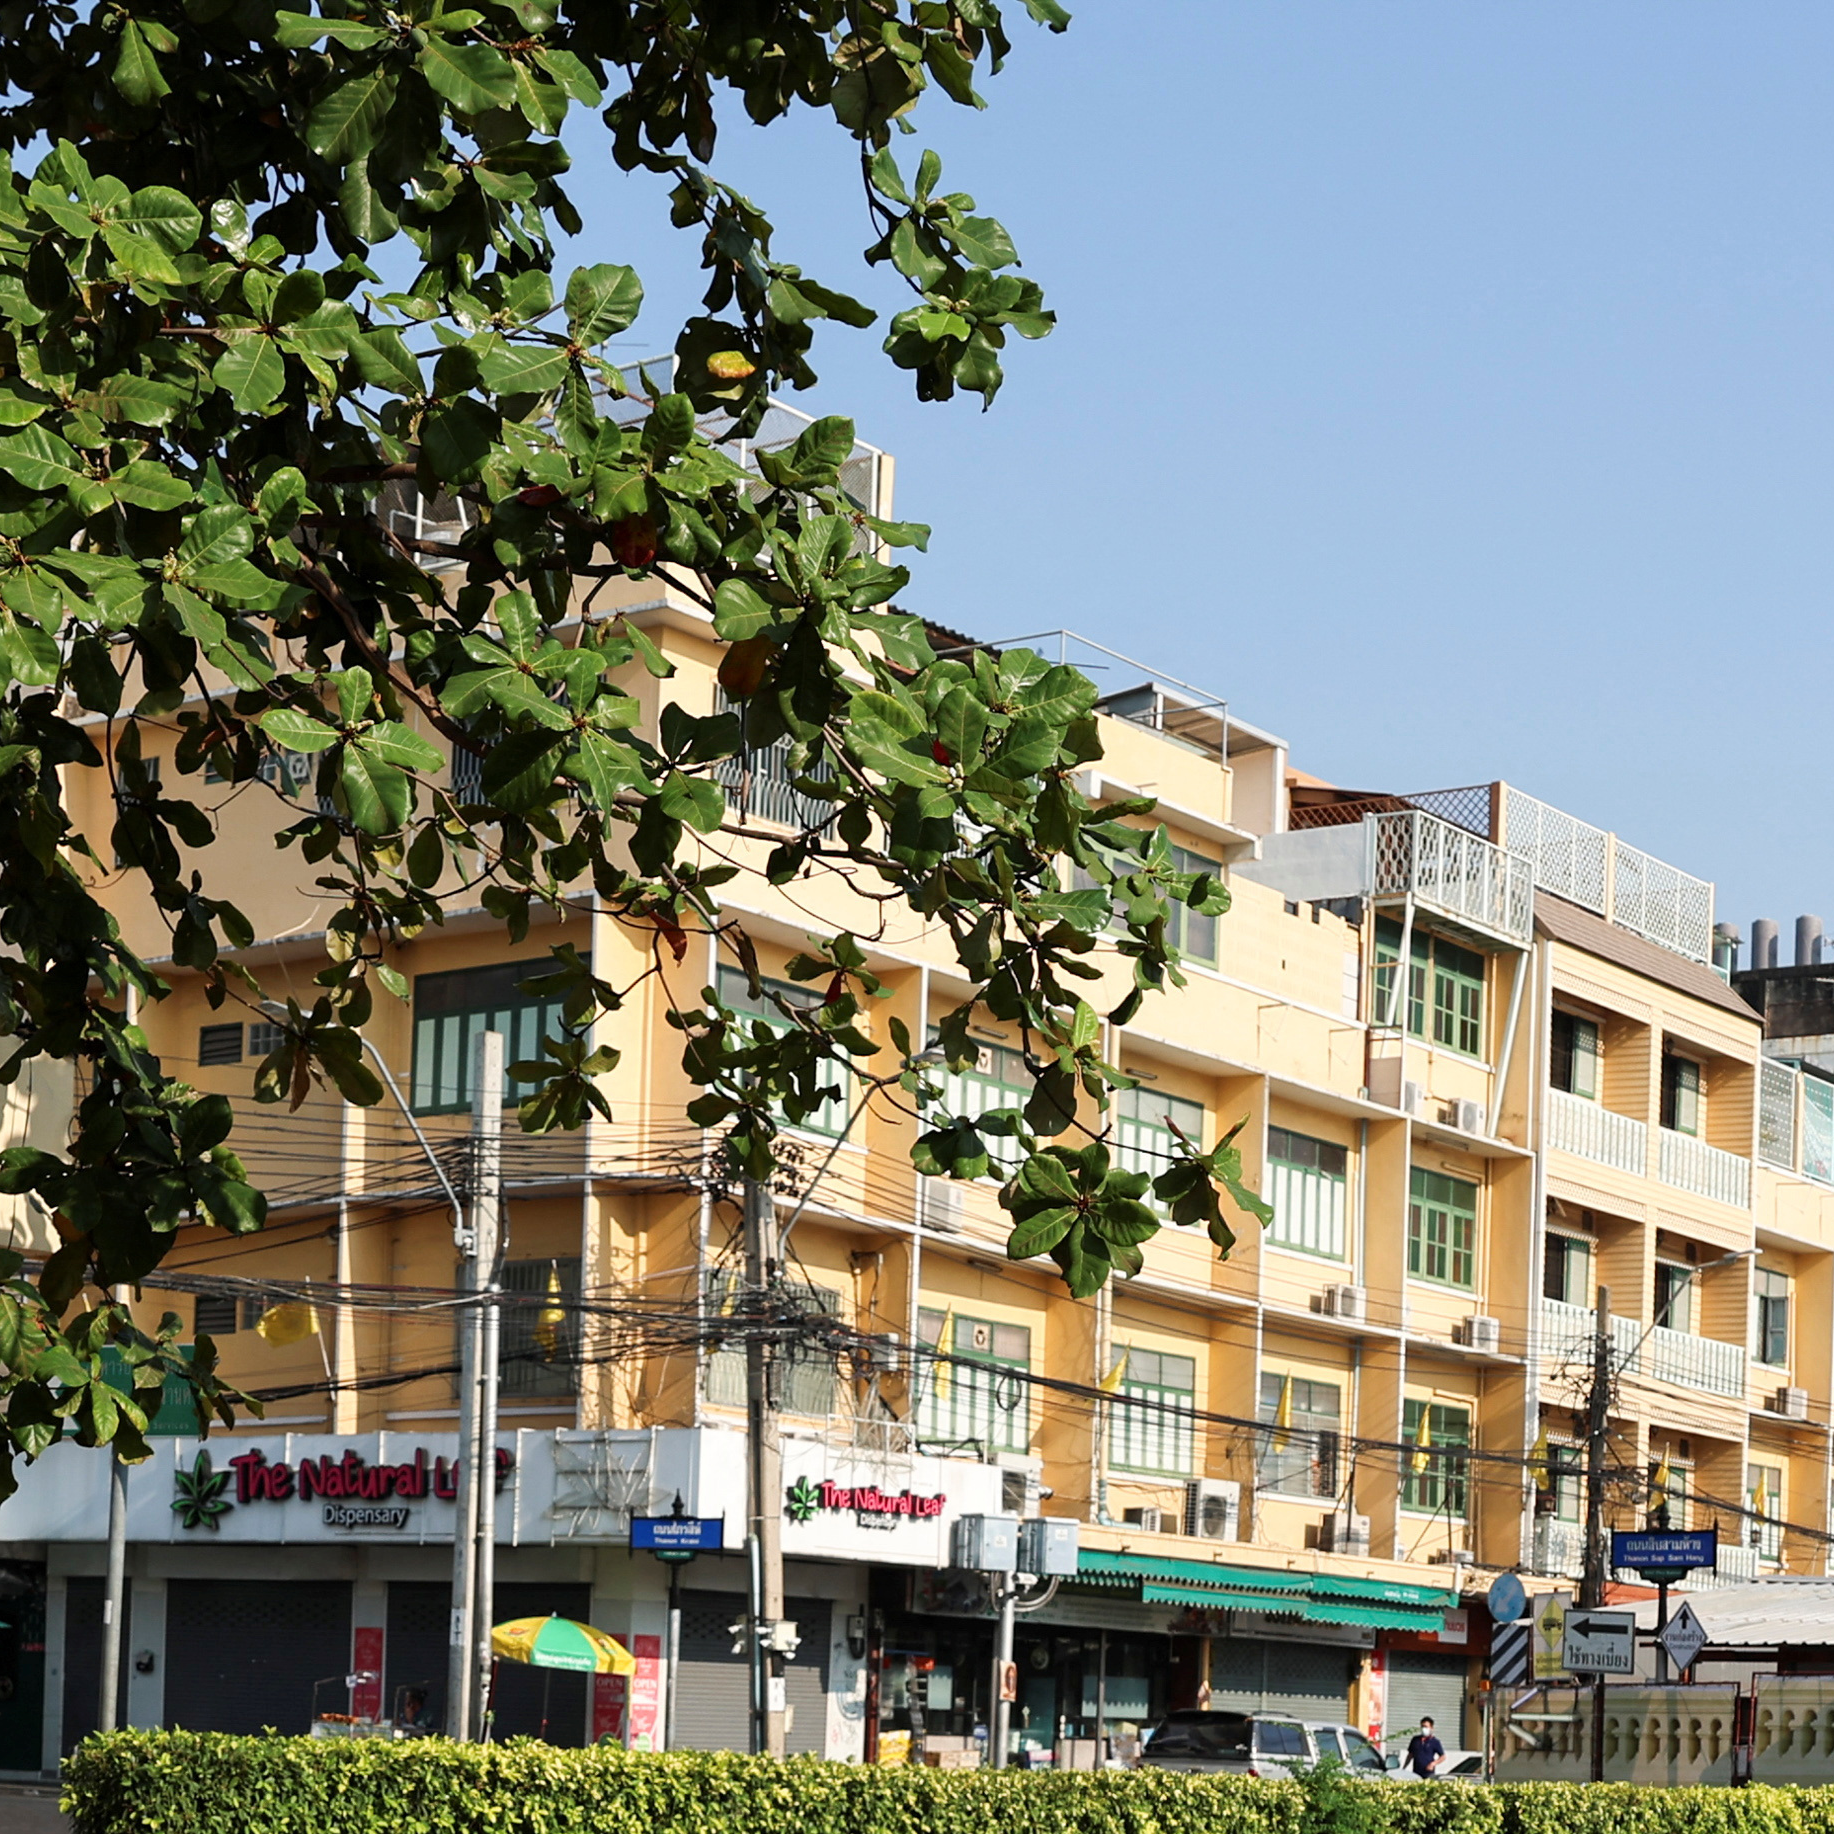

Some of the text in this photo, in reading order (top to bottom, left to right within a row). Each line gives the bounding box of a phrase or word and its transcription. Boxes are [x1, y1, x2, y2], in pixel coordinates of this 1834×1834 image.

[230, 1449, 291, 1502] The
[299, 1448, 425, 1501] Natural
[821, 1480, 946, 1517] The Natural Leaf
[323, 1504, 408, 1527] Dispensary
[1686, 1555, 1704, 1563] Hang
[1568, 1642, 1629, 1668] ใช้ทางเบี่ยง
[596, 1677, 624, 1688] OPEN
[633, 1678, 658, 1689] OPEN
